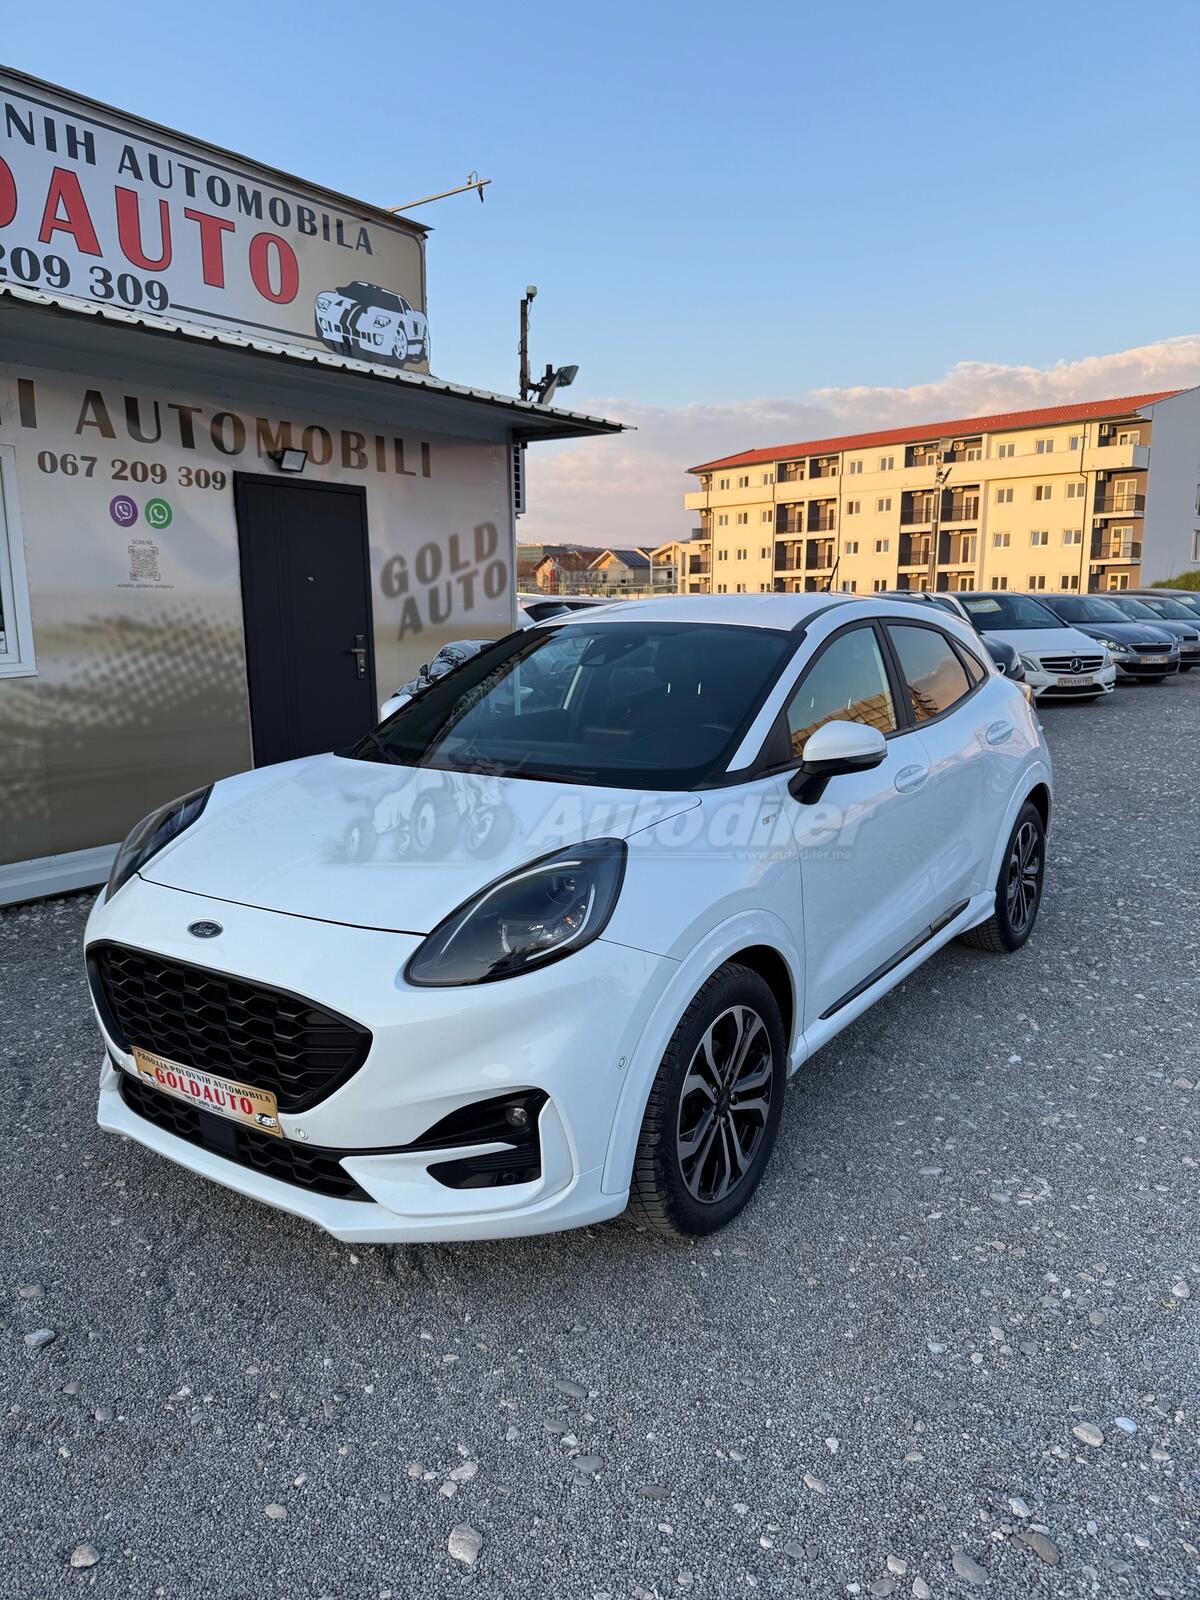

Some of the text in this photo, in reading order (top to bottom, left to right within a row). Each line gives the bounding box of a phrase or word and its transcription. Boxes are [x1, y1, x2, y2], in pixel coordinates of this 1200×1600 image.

[117, 144, 374, 256] AUTOMOBILA
[89, 265, 170, 311] 309
[75, 389, 432, 478] AUTOMOBILI
[37, 450, 227, 491] 067 209 309
[381, 520, 498, 599] GOLD
[398, 559, 508, 642] AUTO
[137, 1051, 272, 1103] PRODAJA POLOVNIH AUTOMOBILA
[154, 1066, 254, 1115] GOLDAUTO
